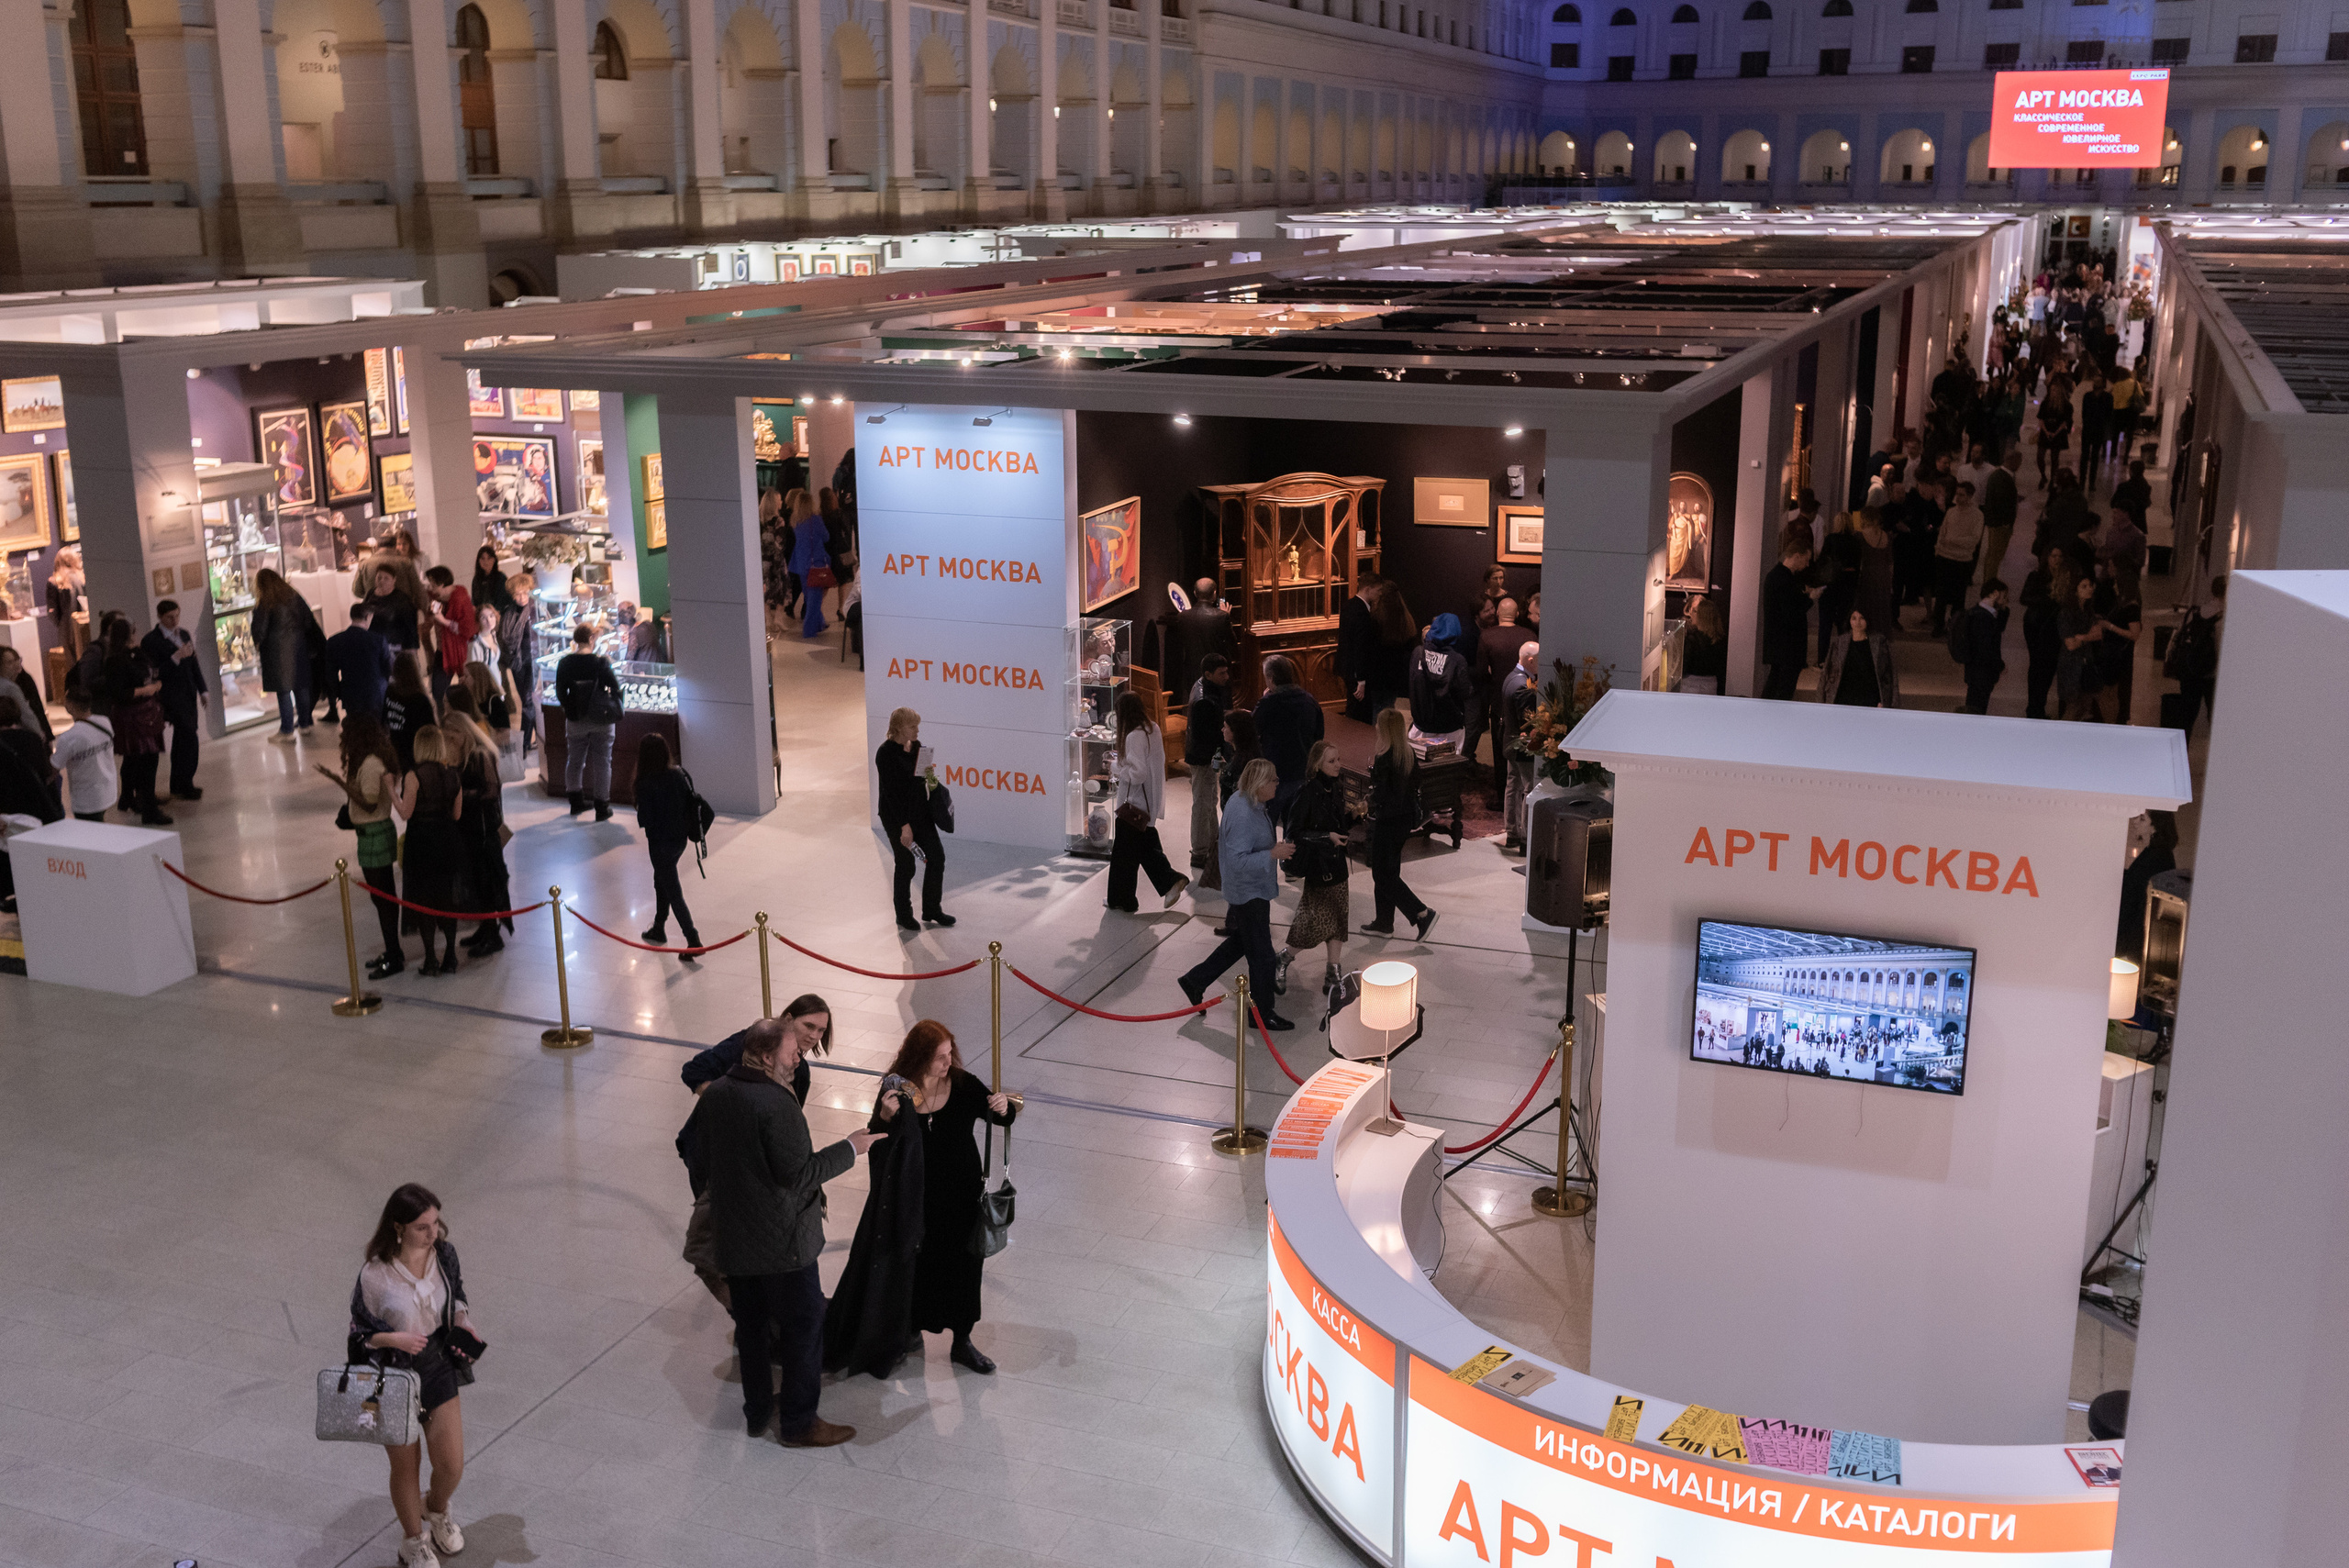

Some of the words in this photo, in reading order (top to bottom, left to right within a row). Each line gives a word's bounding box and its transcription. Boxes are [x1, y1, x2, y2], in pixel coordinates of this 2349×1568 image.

[2014, 90, 2055, 108] АРТ
[2059, 89, 2143, 108] МОСКВА
[2013, 113, 2085, 123] КЛАССИЧЕСКОЕ
[2037, 123, 2106, 133] СОВРЕМЕННОЕ
[2062, 134, 2121, 144] ЮВЕЛИРНОЕ
[2087, 144, 2140, 154] ИСКУССТВО
[879, 445, 926, 468] АРТ
[935, 448, 1039, 474] МОСКВА
[883, 554, 930, 576] АРТ
[939, 557, 1041, 584] МОСКВА
[887, 657, 933, 681] АРТ
[942, 662, 1044, 691] МОСКВА
[945, 764, 1047, 795] МОСКВА
[48, 857, 87, 880] ВХОД
[1684, 827, 1790, 873] АРТ
[1809, 835, 2041, 899] МОСКВА
[1312, 1286, 1362, 1351] КАССА
[1534, 1425, 1782, 1518] ИНФОРМАЦИЯ
[1792, 1493, 1810, 1524] /
[1820, 1498, 2017, 1541] КАТАЛОГИ
